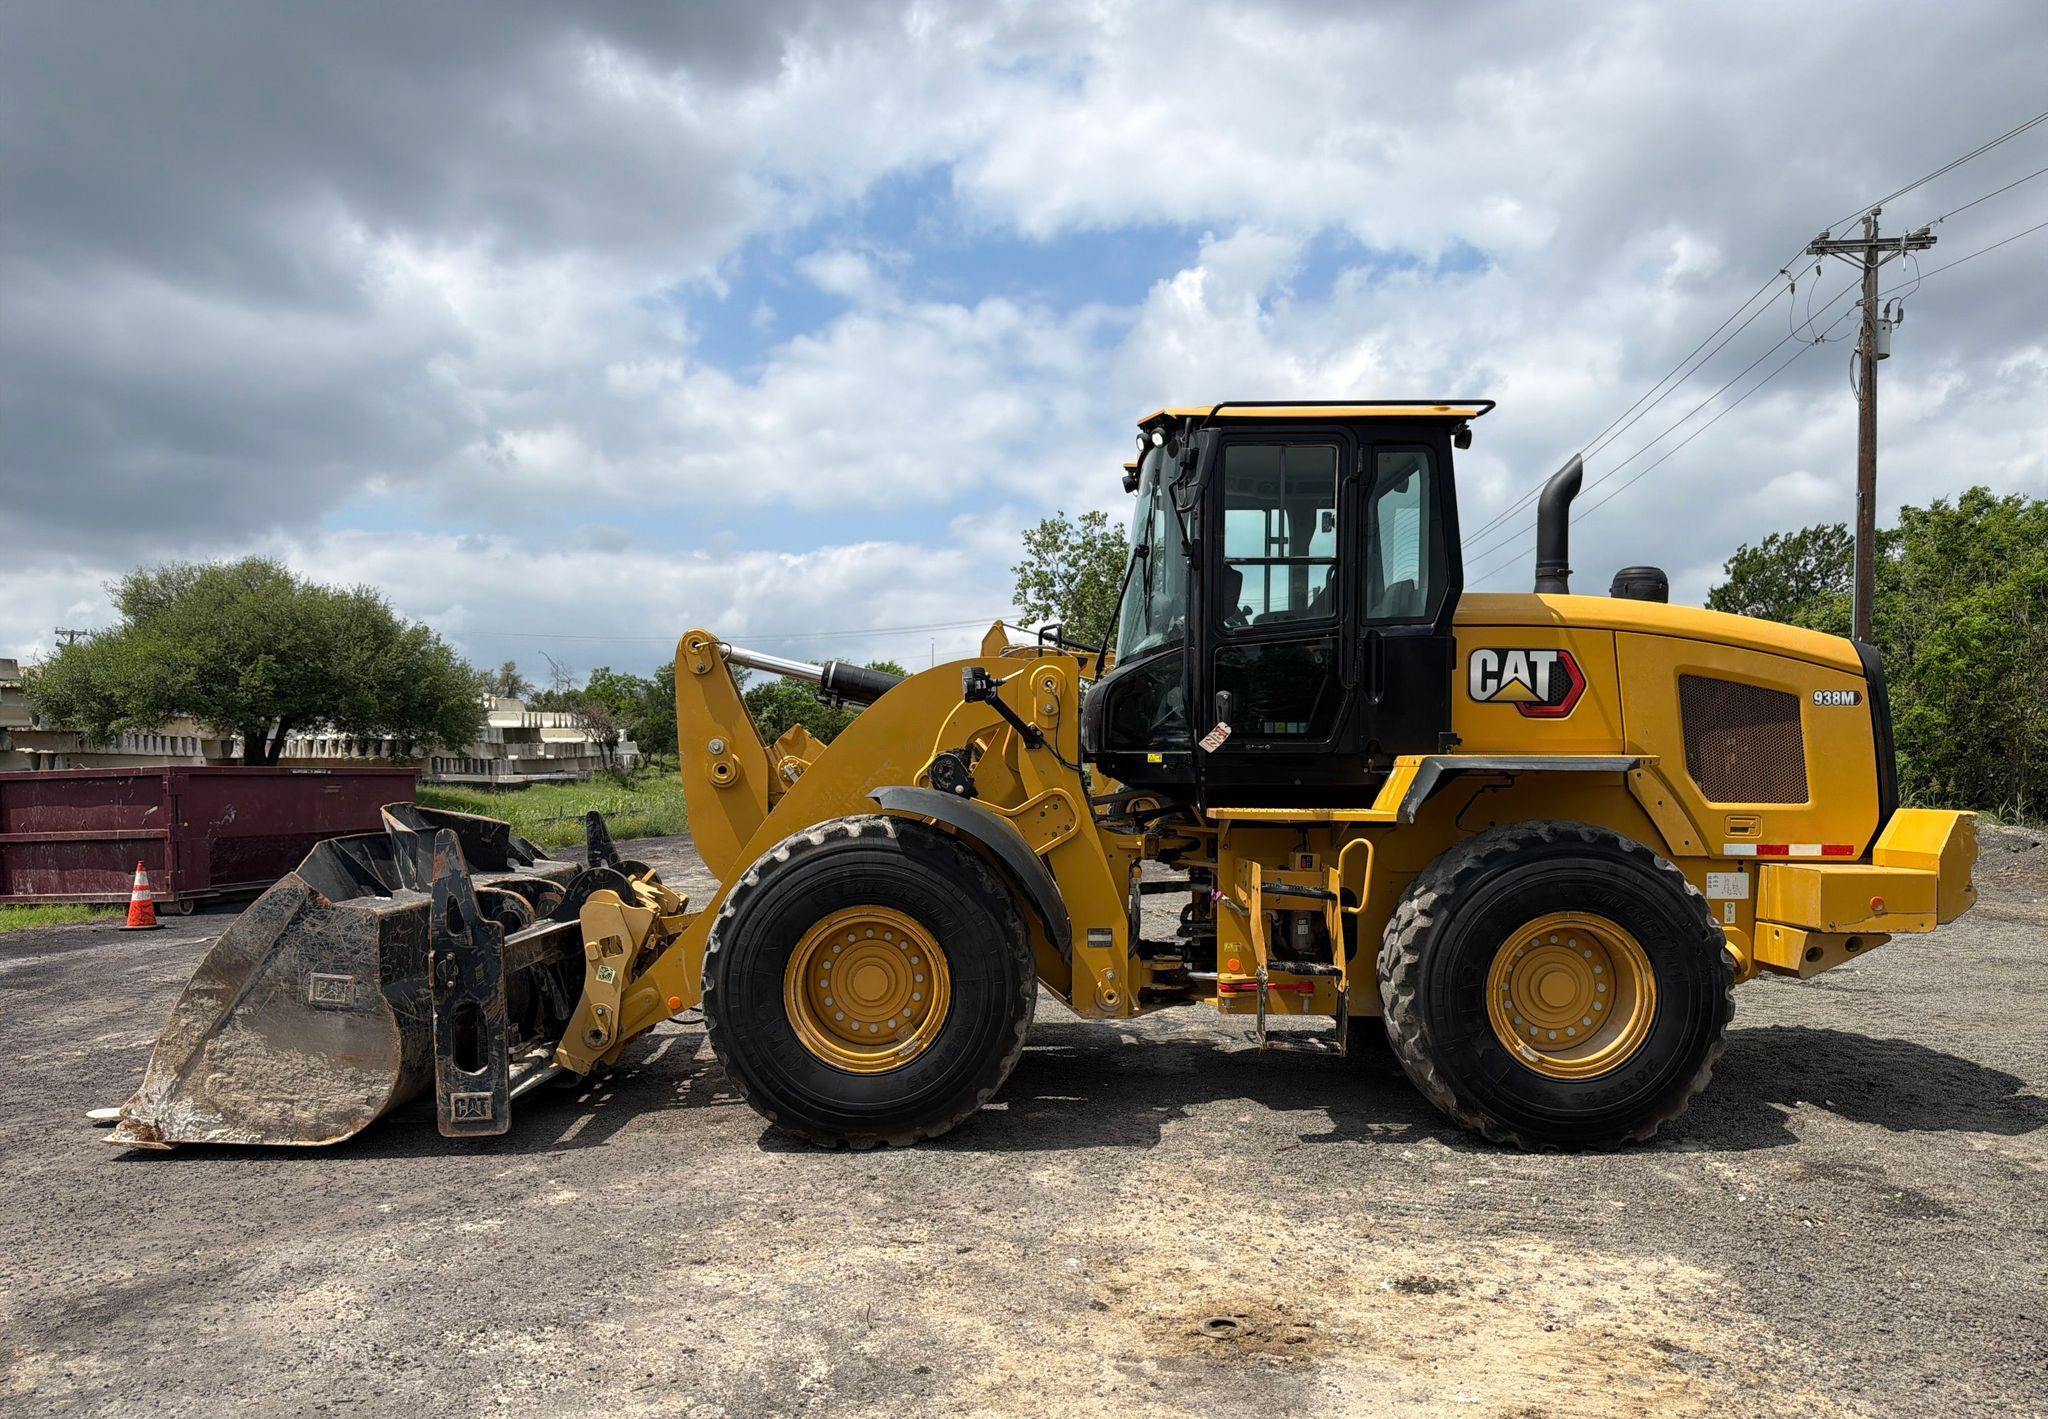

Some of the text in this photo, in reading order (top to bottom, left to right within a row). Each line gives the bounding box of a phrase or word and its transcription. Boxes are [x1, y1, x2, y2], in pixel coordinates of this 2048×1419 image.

[1470, 649, 1558, 702] CAT
[1813, 691, 1855, 705] 938M
[453, 1097, 490, 1119] CAT
